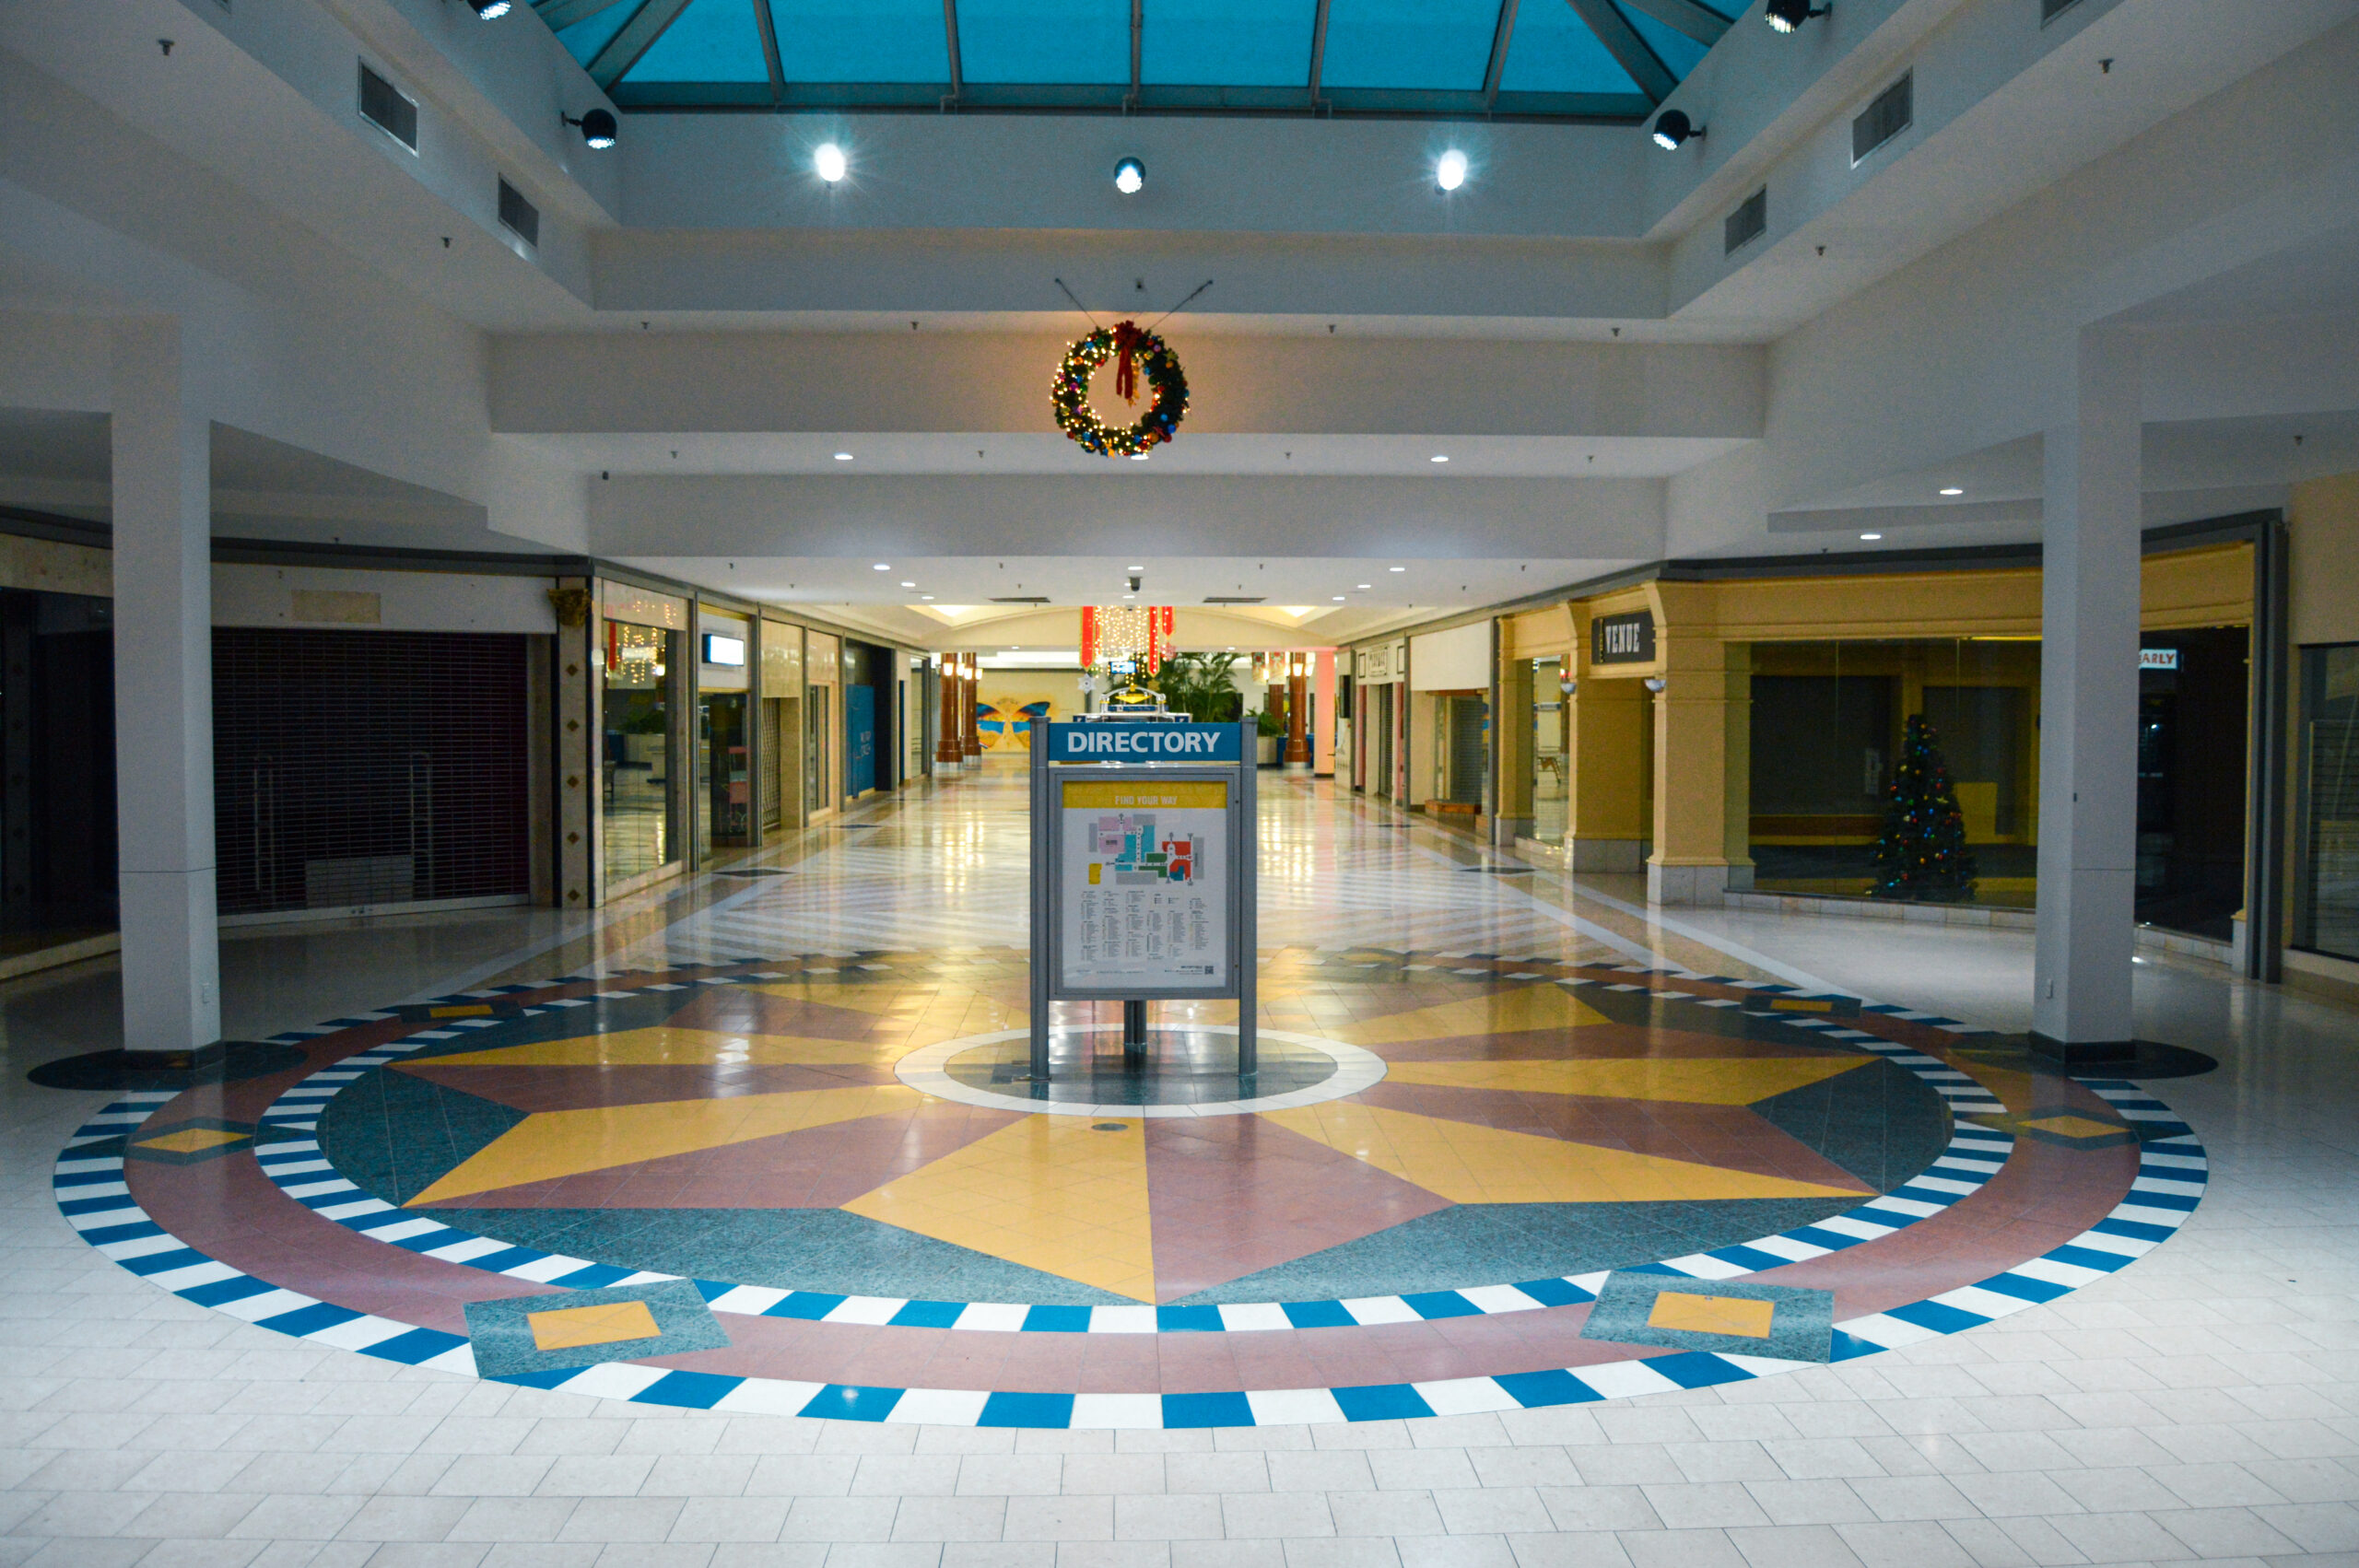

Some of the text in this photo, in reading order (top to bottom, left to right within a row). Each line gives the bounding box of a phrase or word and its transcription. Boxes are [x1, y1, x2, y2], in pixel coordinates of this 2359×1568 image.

[1605, 623, 1640, 653] VENUE
[1067, 731, 1221, 753] DIRECTORY
[1115, 796, 1178, 805] FIND YOUR WAY
